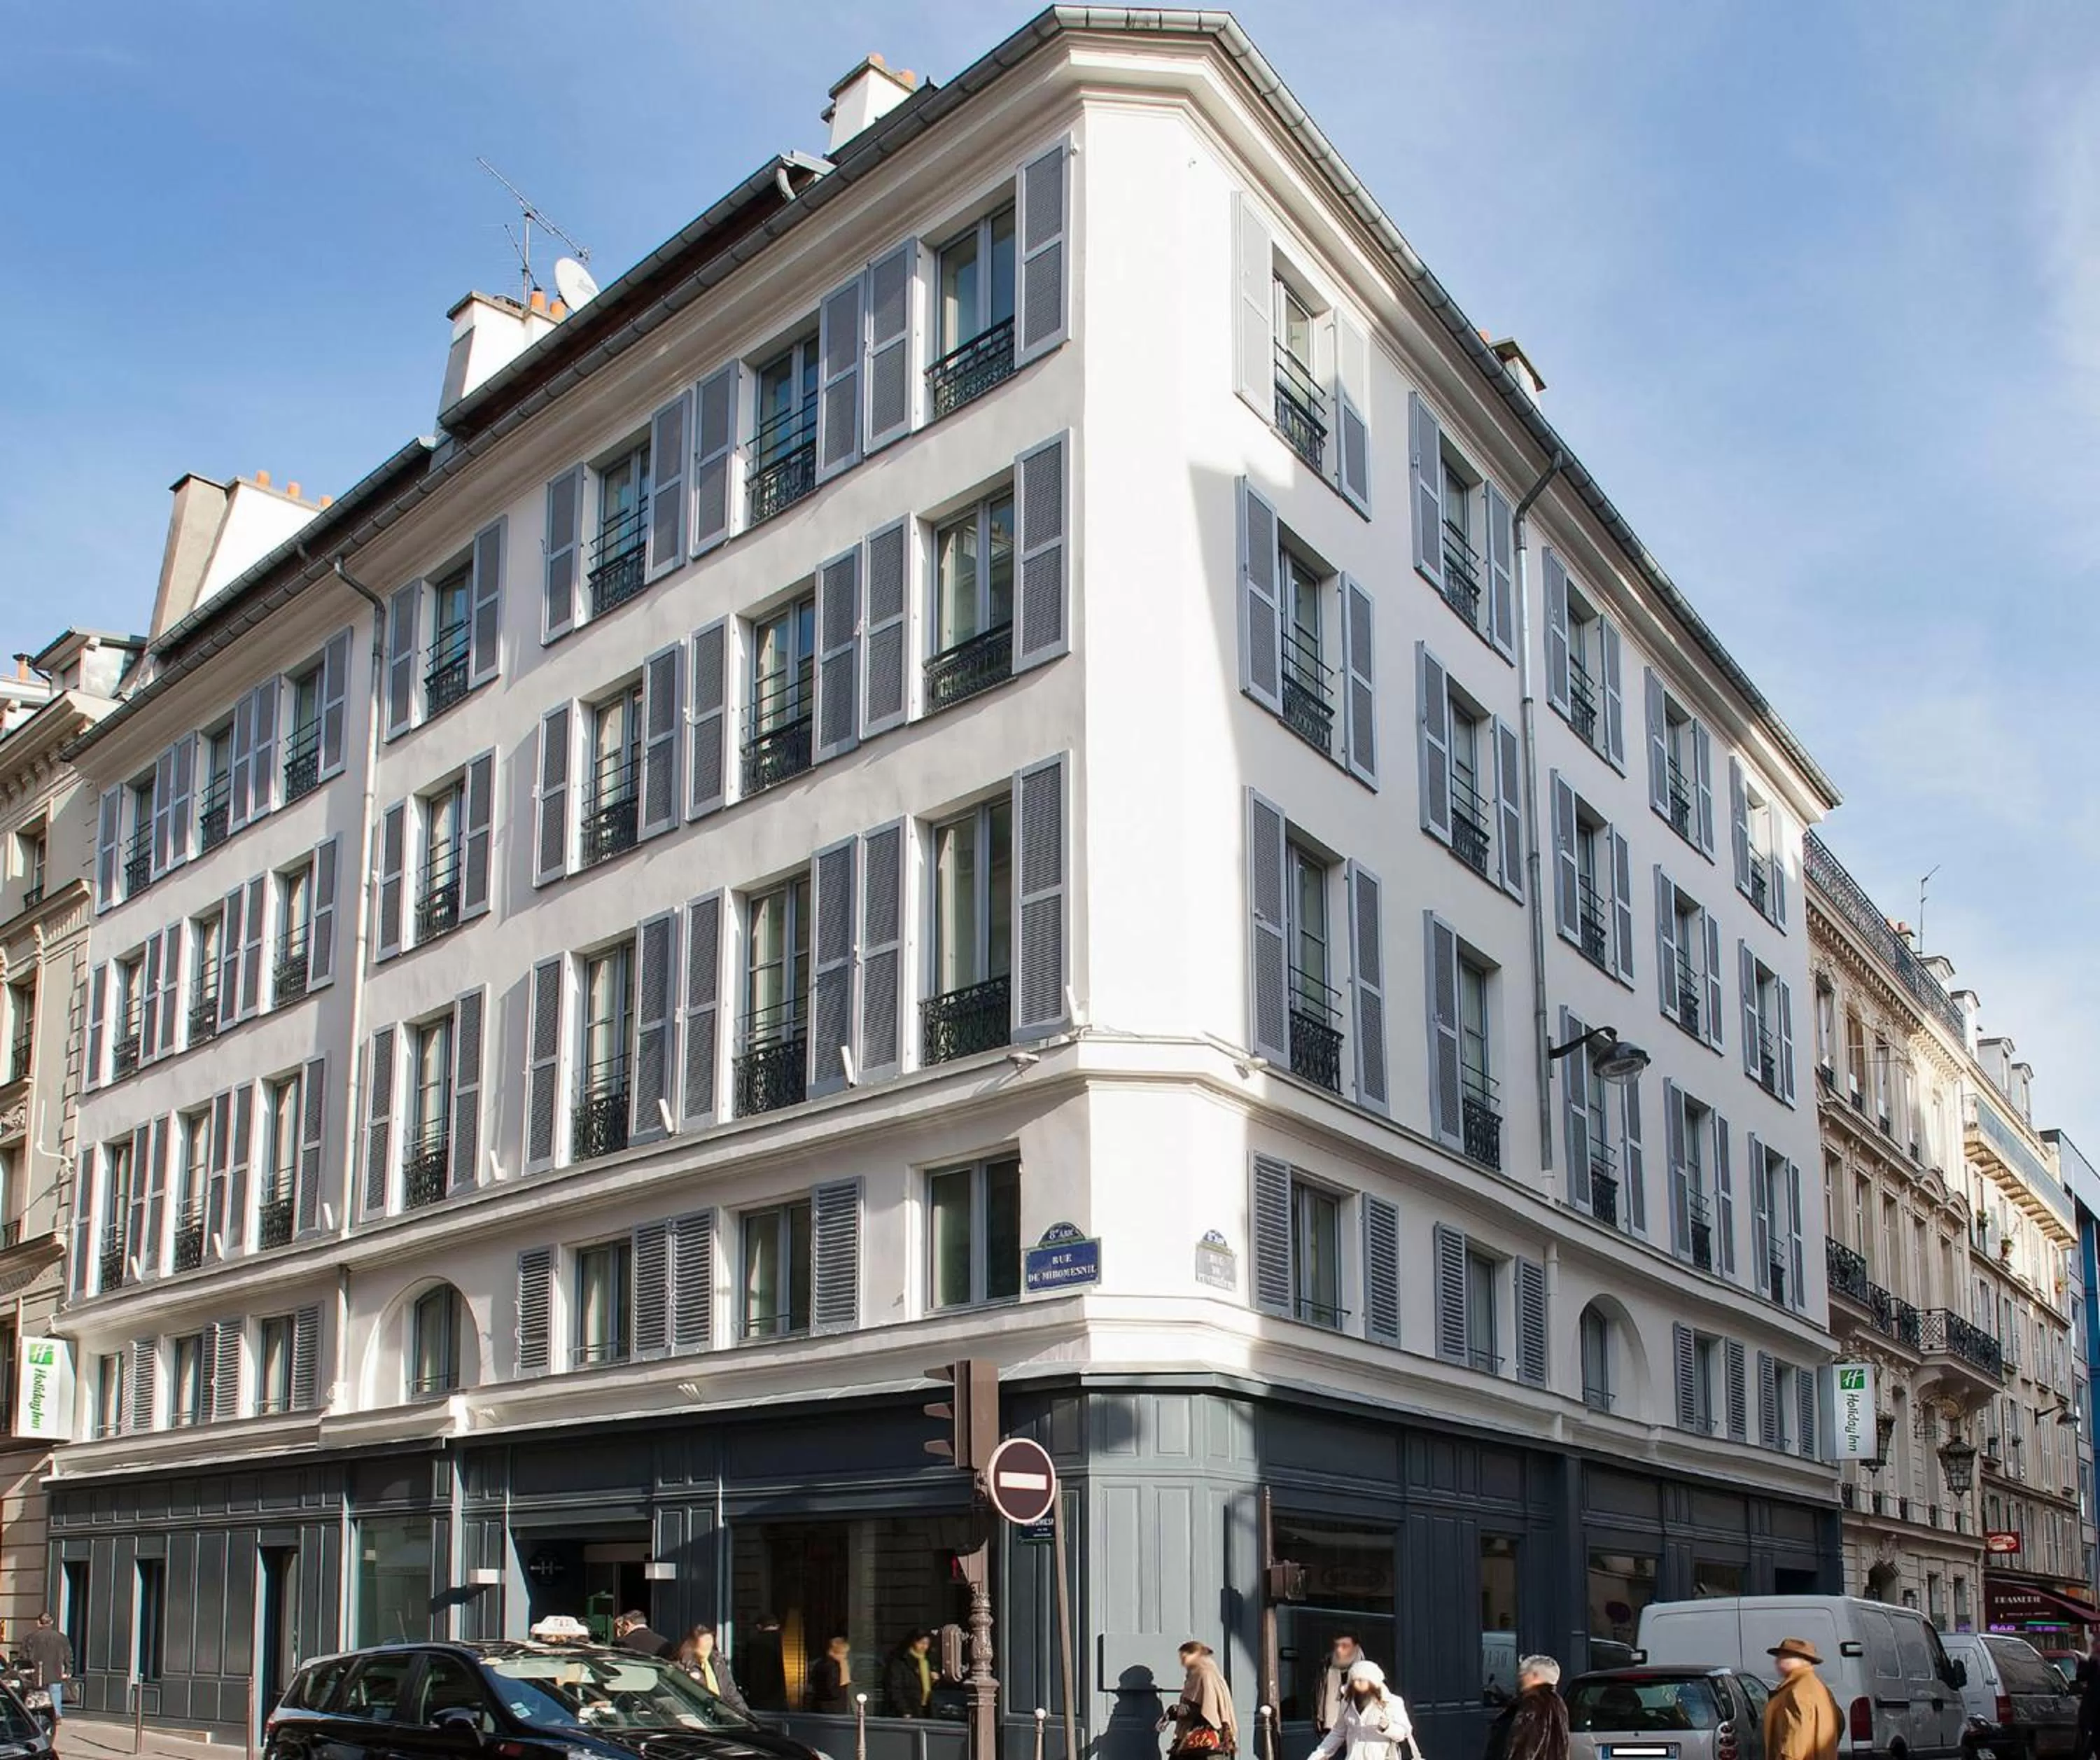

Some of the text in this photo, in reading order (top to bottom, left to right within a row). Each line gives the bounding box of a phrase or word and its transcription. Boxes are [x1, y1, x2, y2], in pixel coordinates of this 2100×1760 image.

[1028, 1264, 1097, 1283] DE MIROMESNIL
[1052, 1254, 1072, 1264] RUE
[29, 1367, 46, 1429] Holiday Inn
[1844, 1392, 1860, 1452] Holiday Inn
